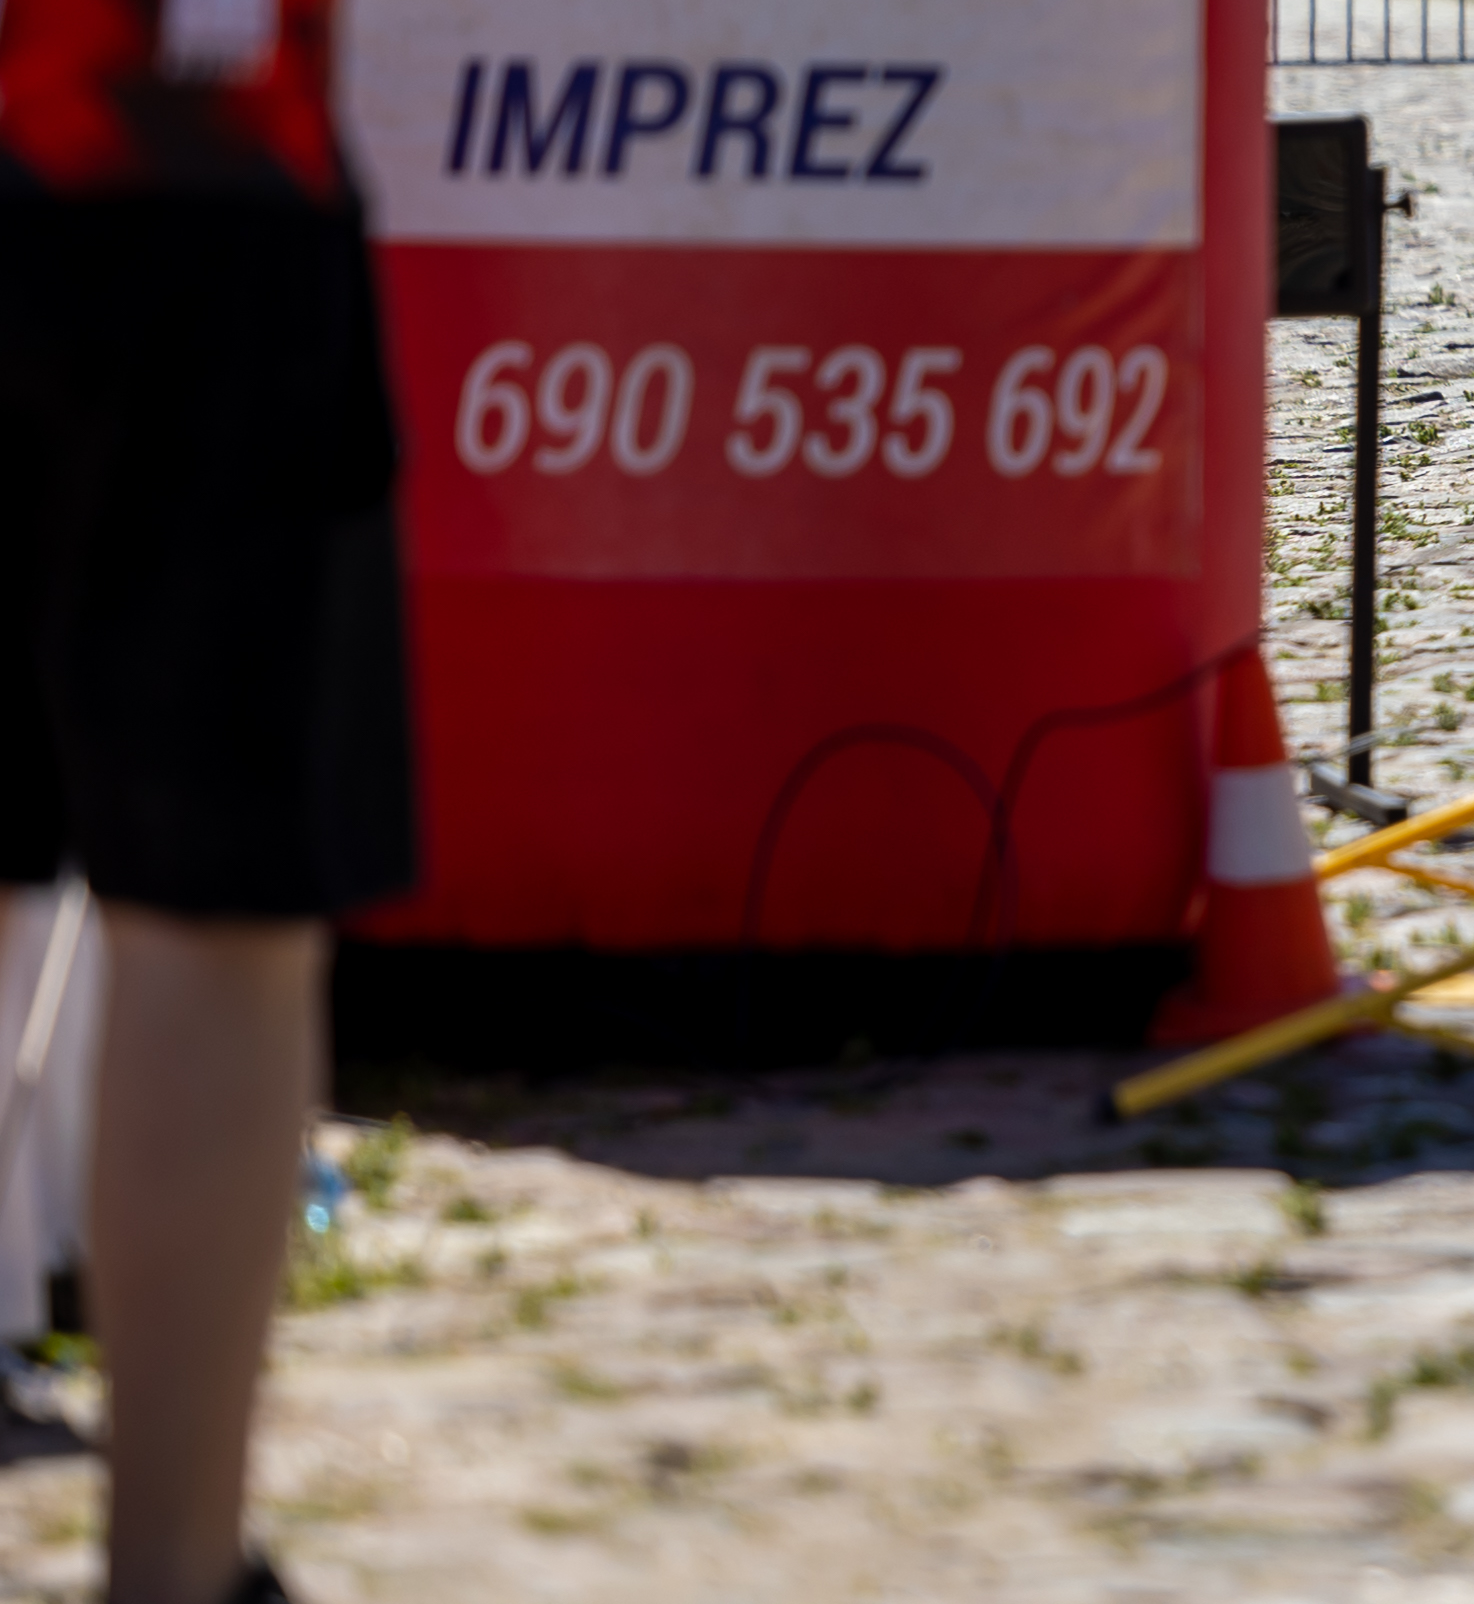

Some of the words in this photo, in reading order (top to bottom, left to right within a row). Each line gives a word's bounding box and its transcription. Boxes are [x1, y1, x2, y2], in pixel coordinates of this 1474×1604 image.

[443, 56, 945, 186] IMPREZ
[454, 339, 697, 478] 690
[724, 343, 964, 479] 535
[984, 342, 1171, 479] 692
